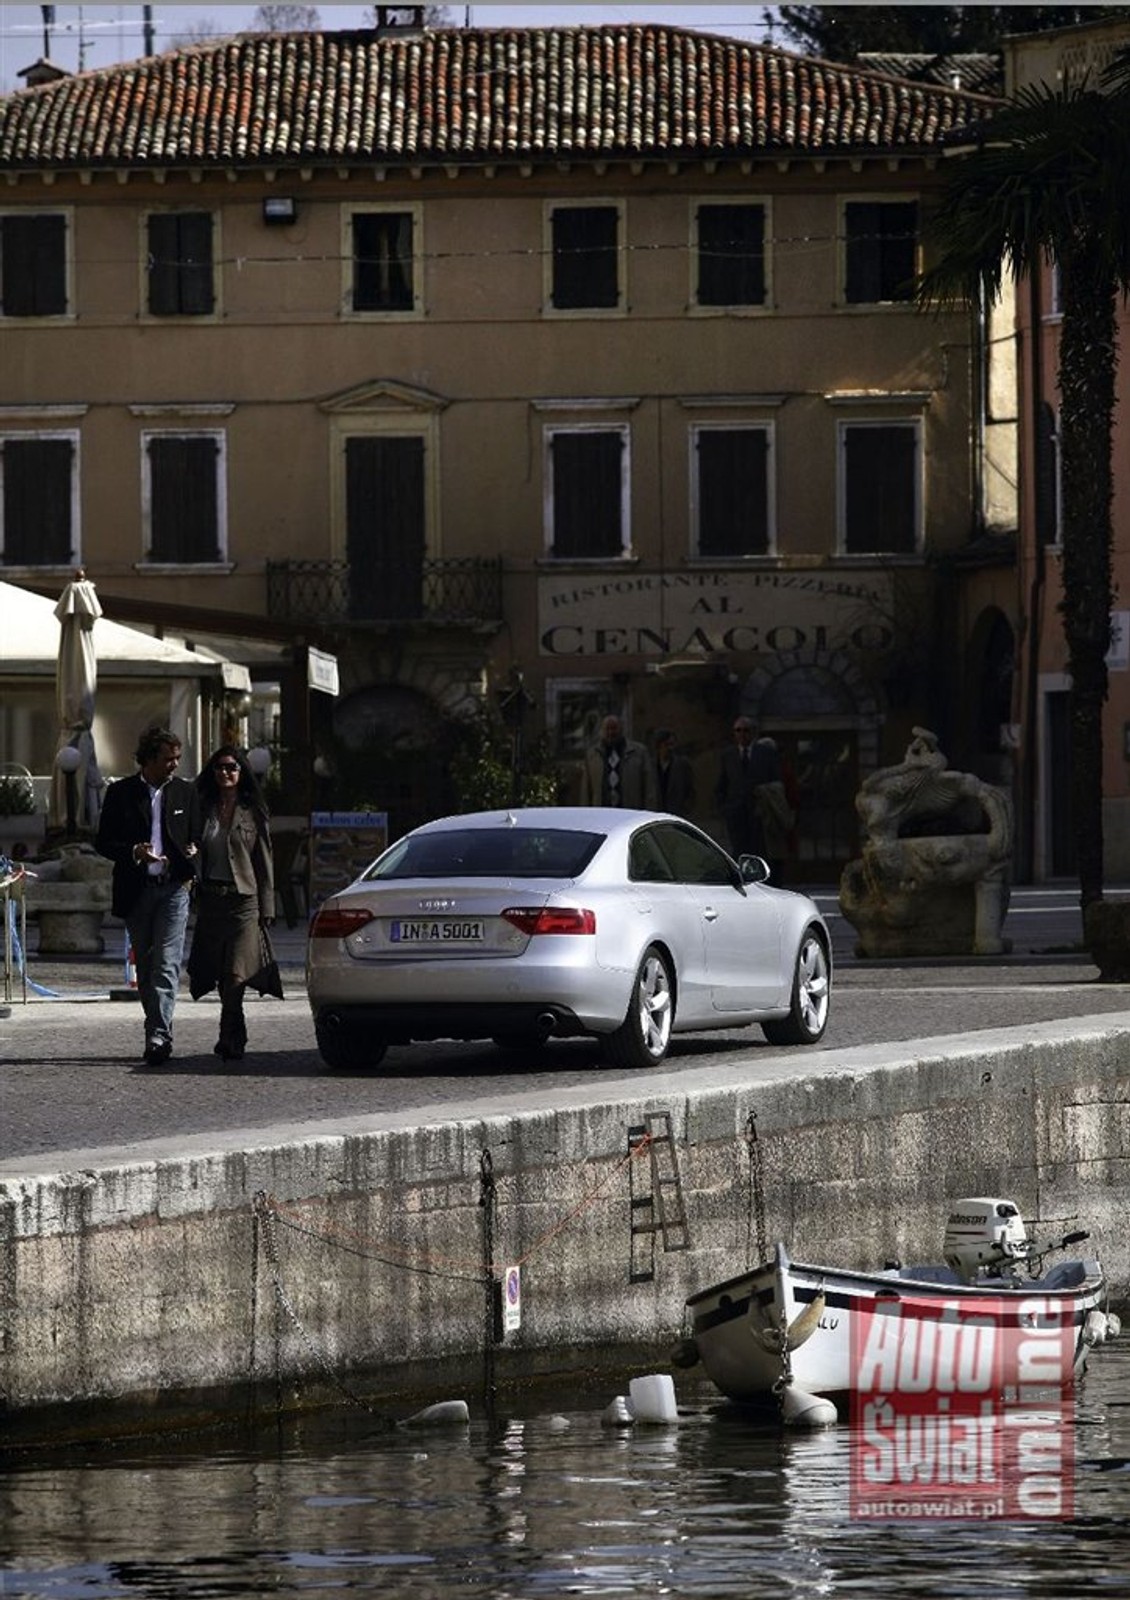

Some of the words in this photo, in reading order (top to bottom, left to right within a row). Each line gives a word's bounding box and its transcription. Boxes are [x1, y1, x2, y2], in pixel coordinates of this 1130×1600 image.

[551, 574, 728, 608] RISTORANTE
[690, 596, 743, 614] AL
[541, 624, 893, 654] CENACOLO
[401, 923, 420, 939] IN
